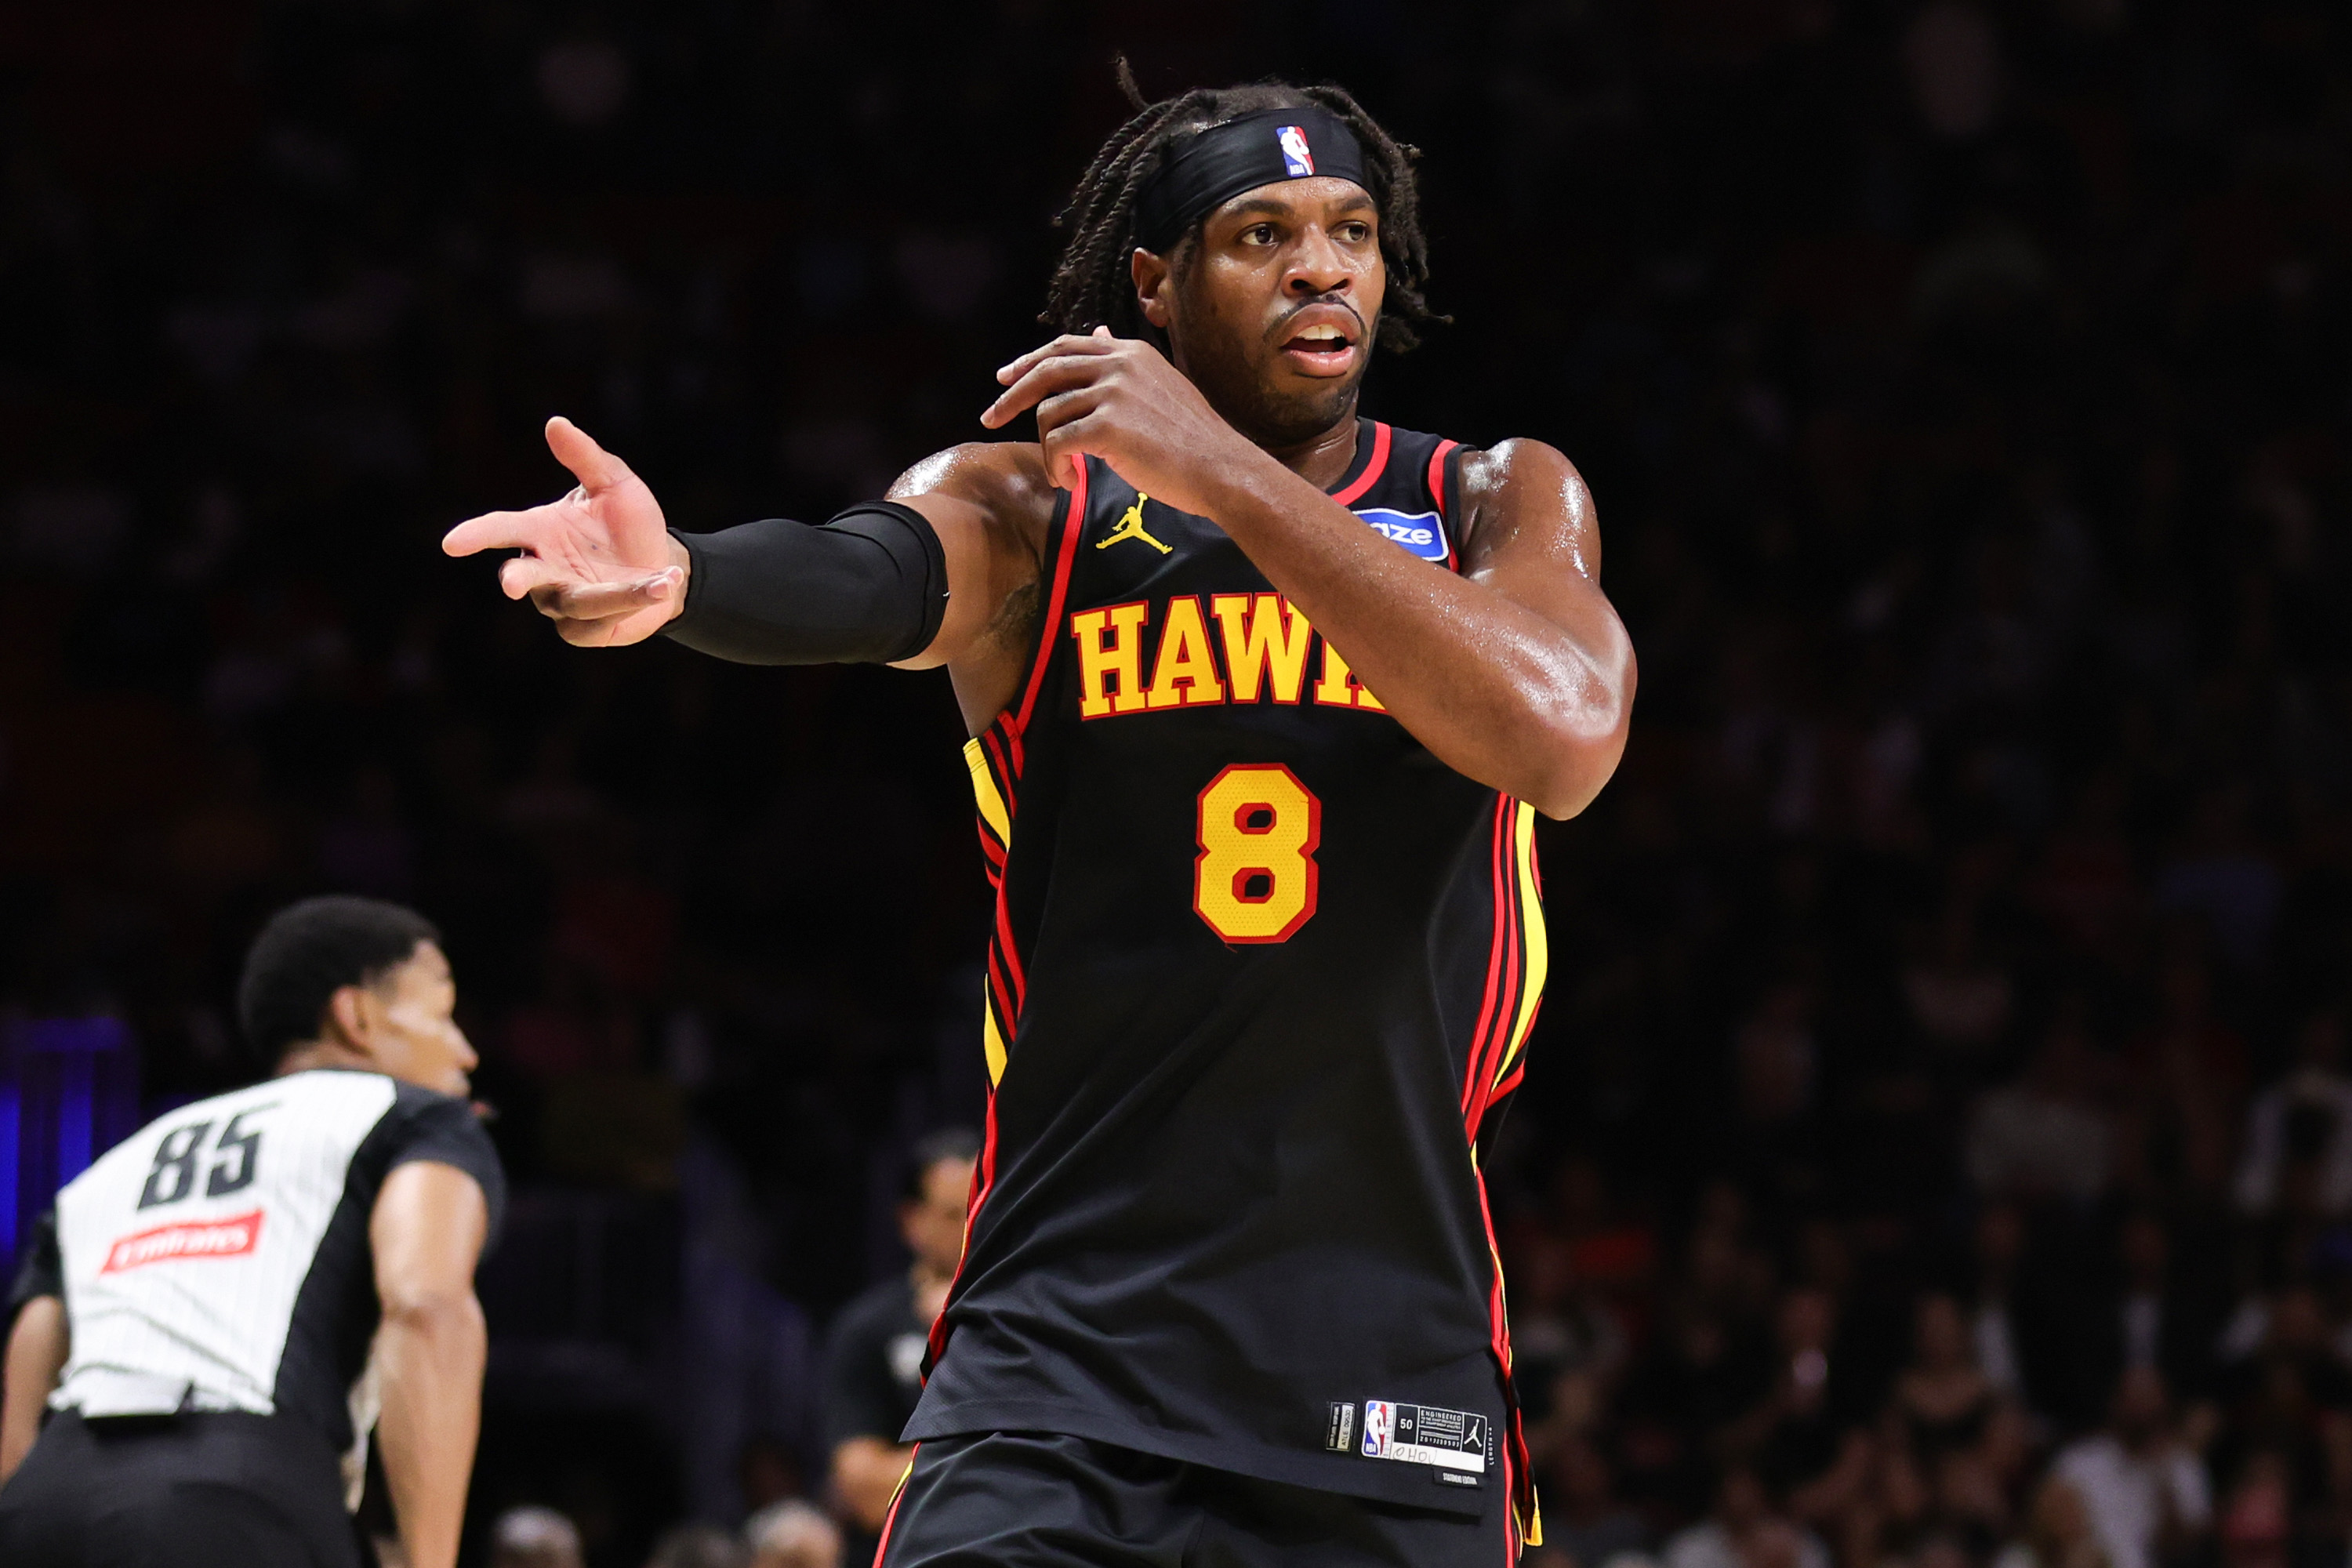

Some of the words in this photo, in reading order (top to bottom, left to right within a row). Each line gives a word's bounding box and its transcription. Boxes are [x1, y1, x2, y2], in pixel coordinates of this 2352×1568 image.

[1070, 592, 1392, 720] HAW
[1192, 762, 1323, 945] 8
[136, 1099, 281, 1210] 85
[1399, 1418, 1413, 1430] 50
